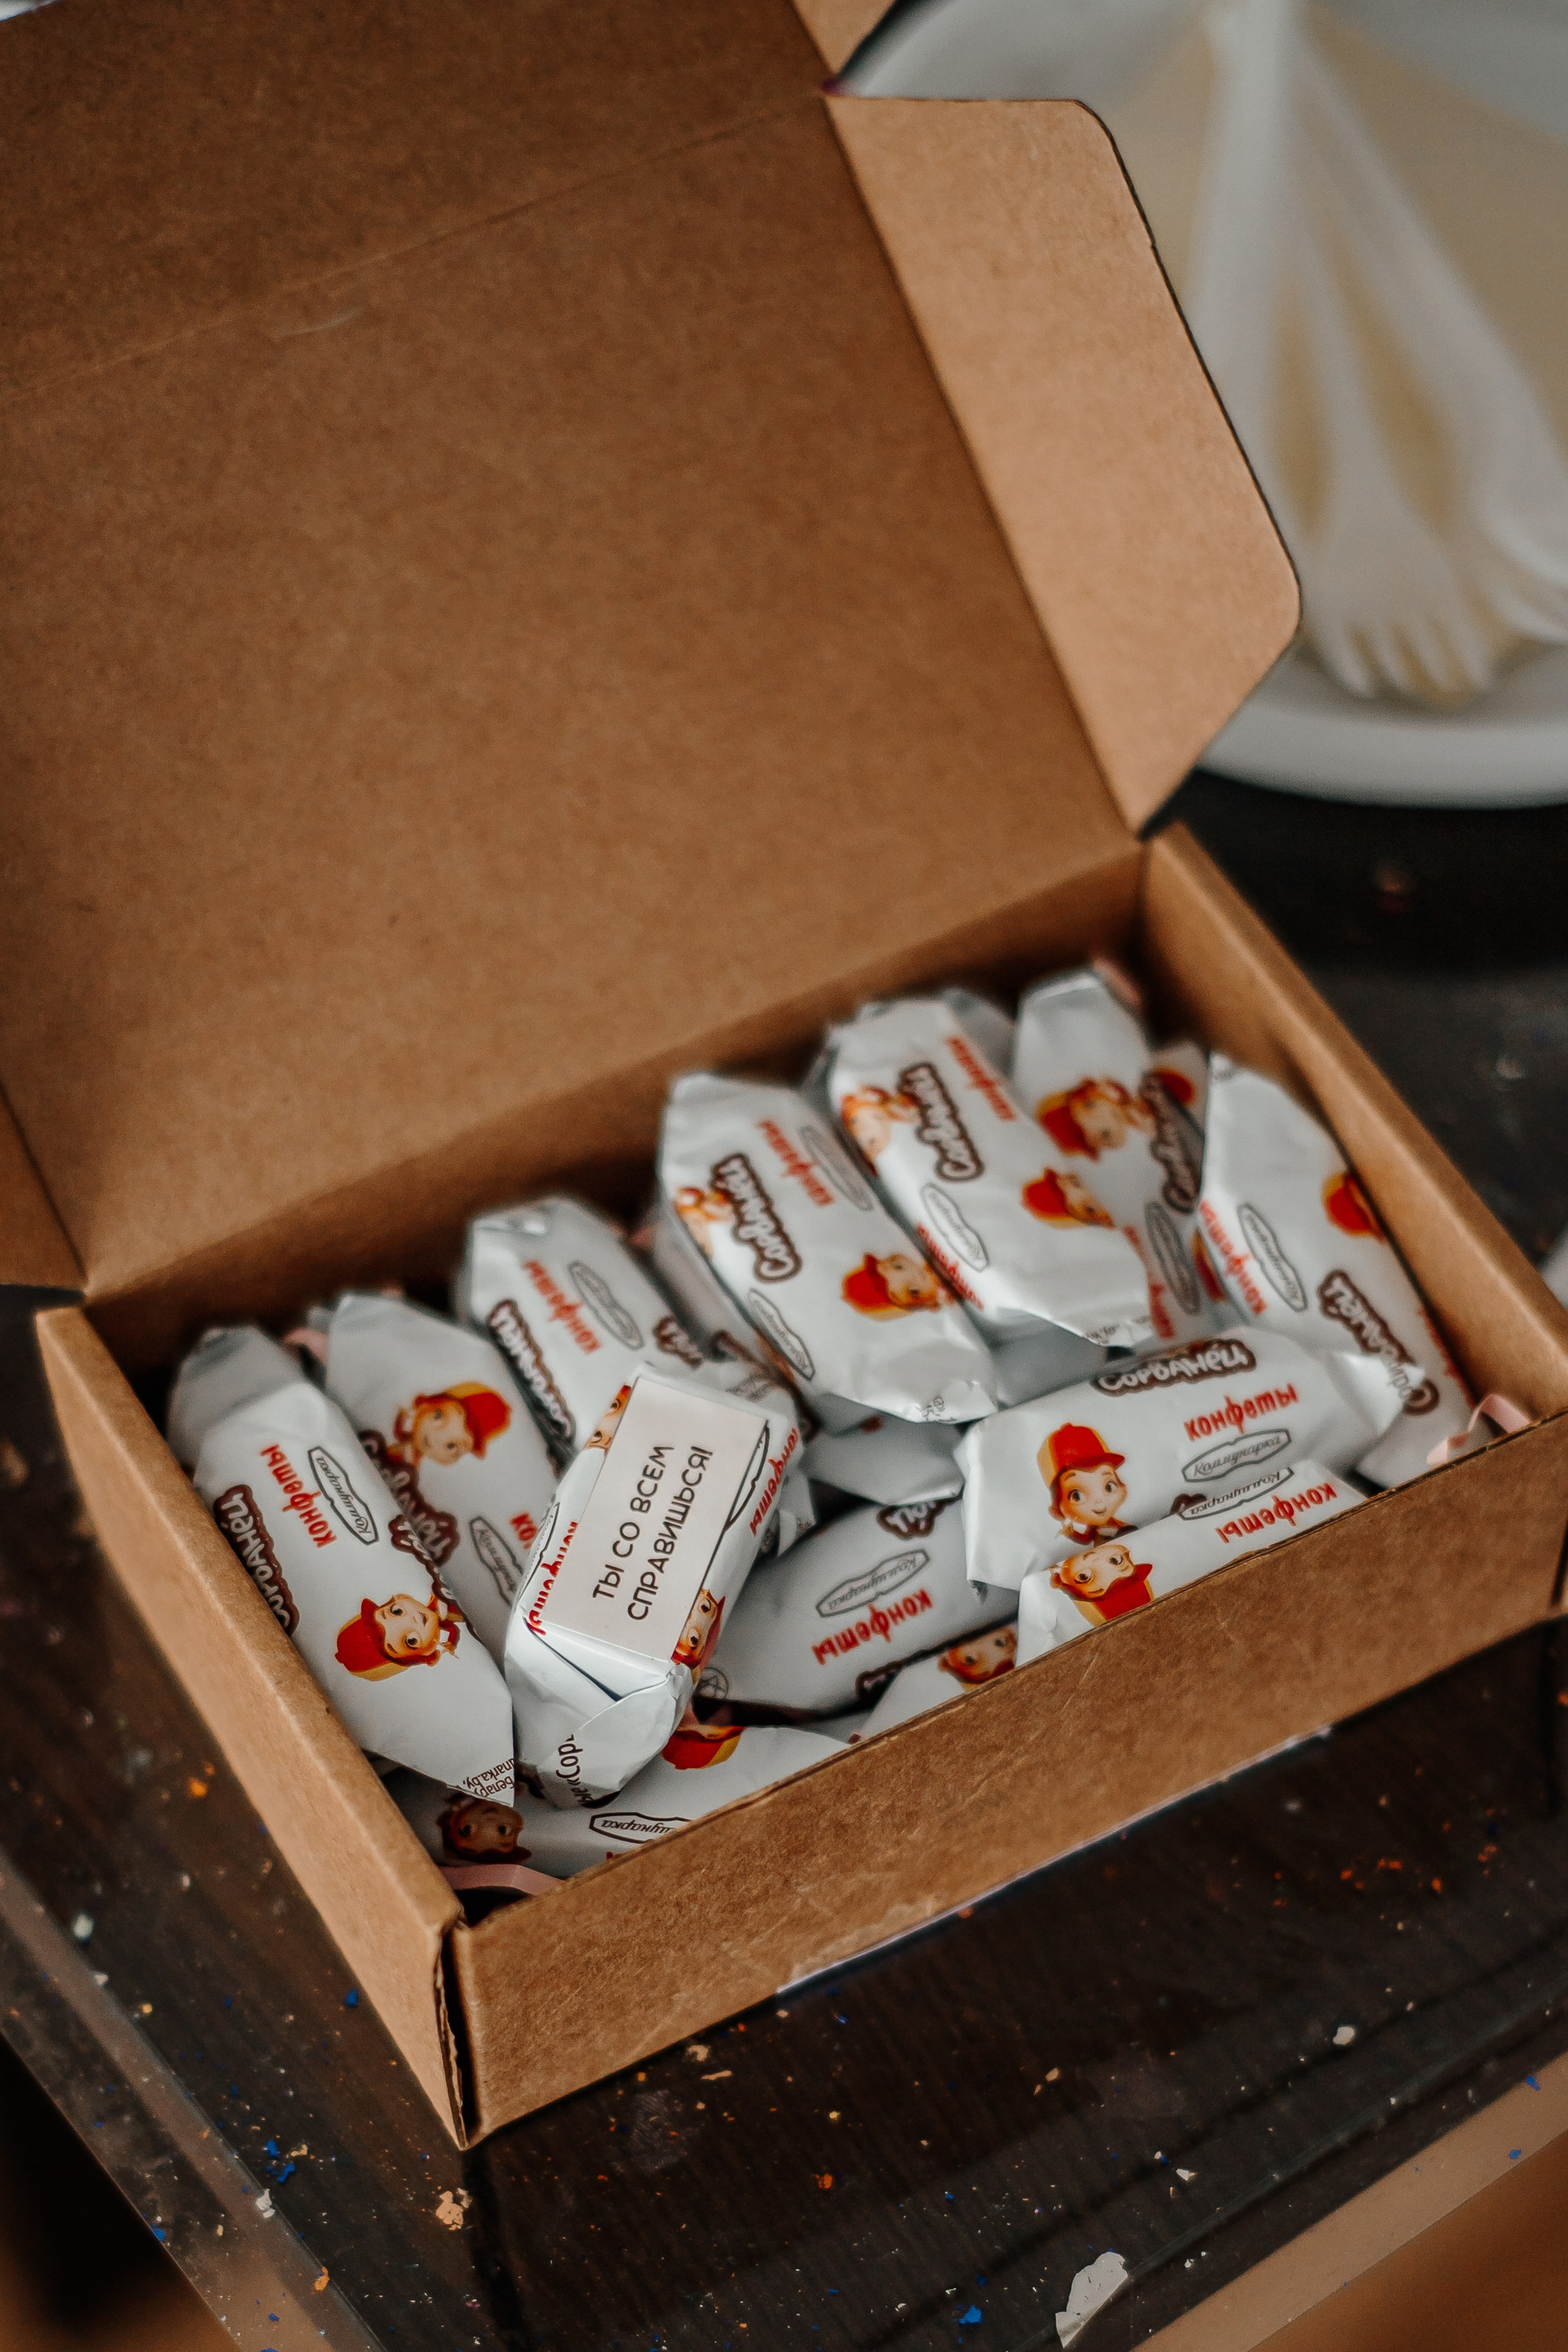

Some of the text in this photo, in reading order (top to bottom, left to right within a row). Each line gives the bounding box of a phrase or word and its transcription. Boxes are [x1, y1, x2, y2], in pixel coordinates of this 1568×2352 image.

[1184, 1382, 1299, 1441] конфеты
[260, 1444, 337, 1548] конфеты
[592, 1446, 674, 1598] ТЫ СО ВСЕМ
[627, 1446, 713, 1620] СПРАВИШЬСЯ!
[1215, 1482, 1337, 1544] конфеты
[812, 1588, 933, 1665] конфеты
